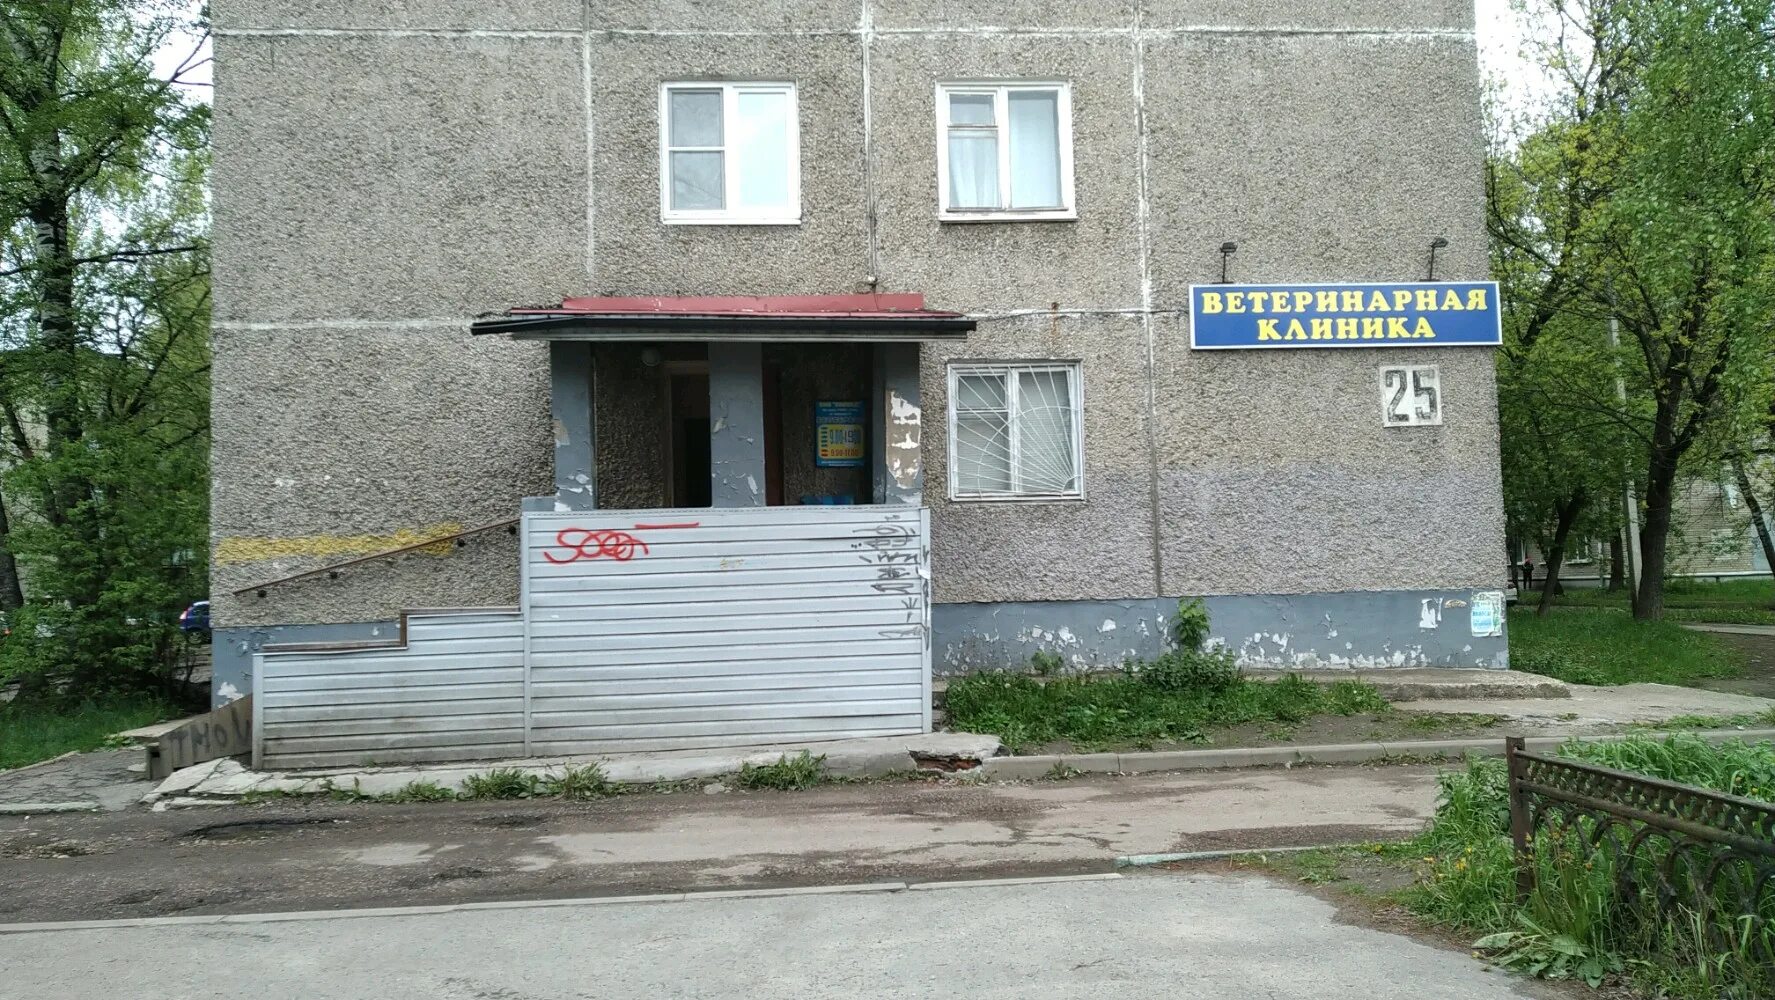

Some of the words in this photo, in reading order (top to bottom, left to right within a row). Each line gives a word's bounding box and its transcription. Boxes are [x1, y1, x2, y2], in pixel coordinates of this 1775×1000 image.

[1201, 288, 1488, 314] ВЕТЕРИНАРНАЯ
[1256, 316, 1437, 341] КЛИНИКА
[1384, 368, 1437, 423] 25
